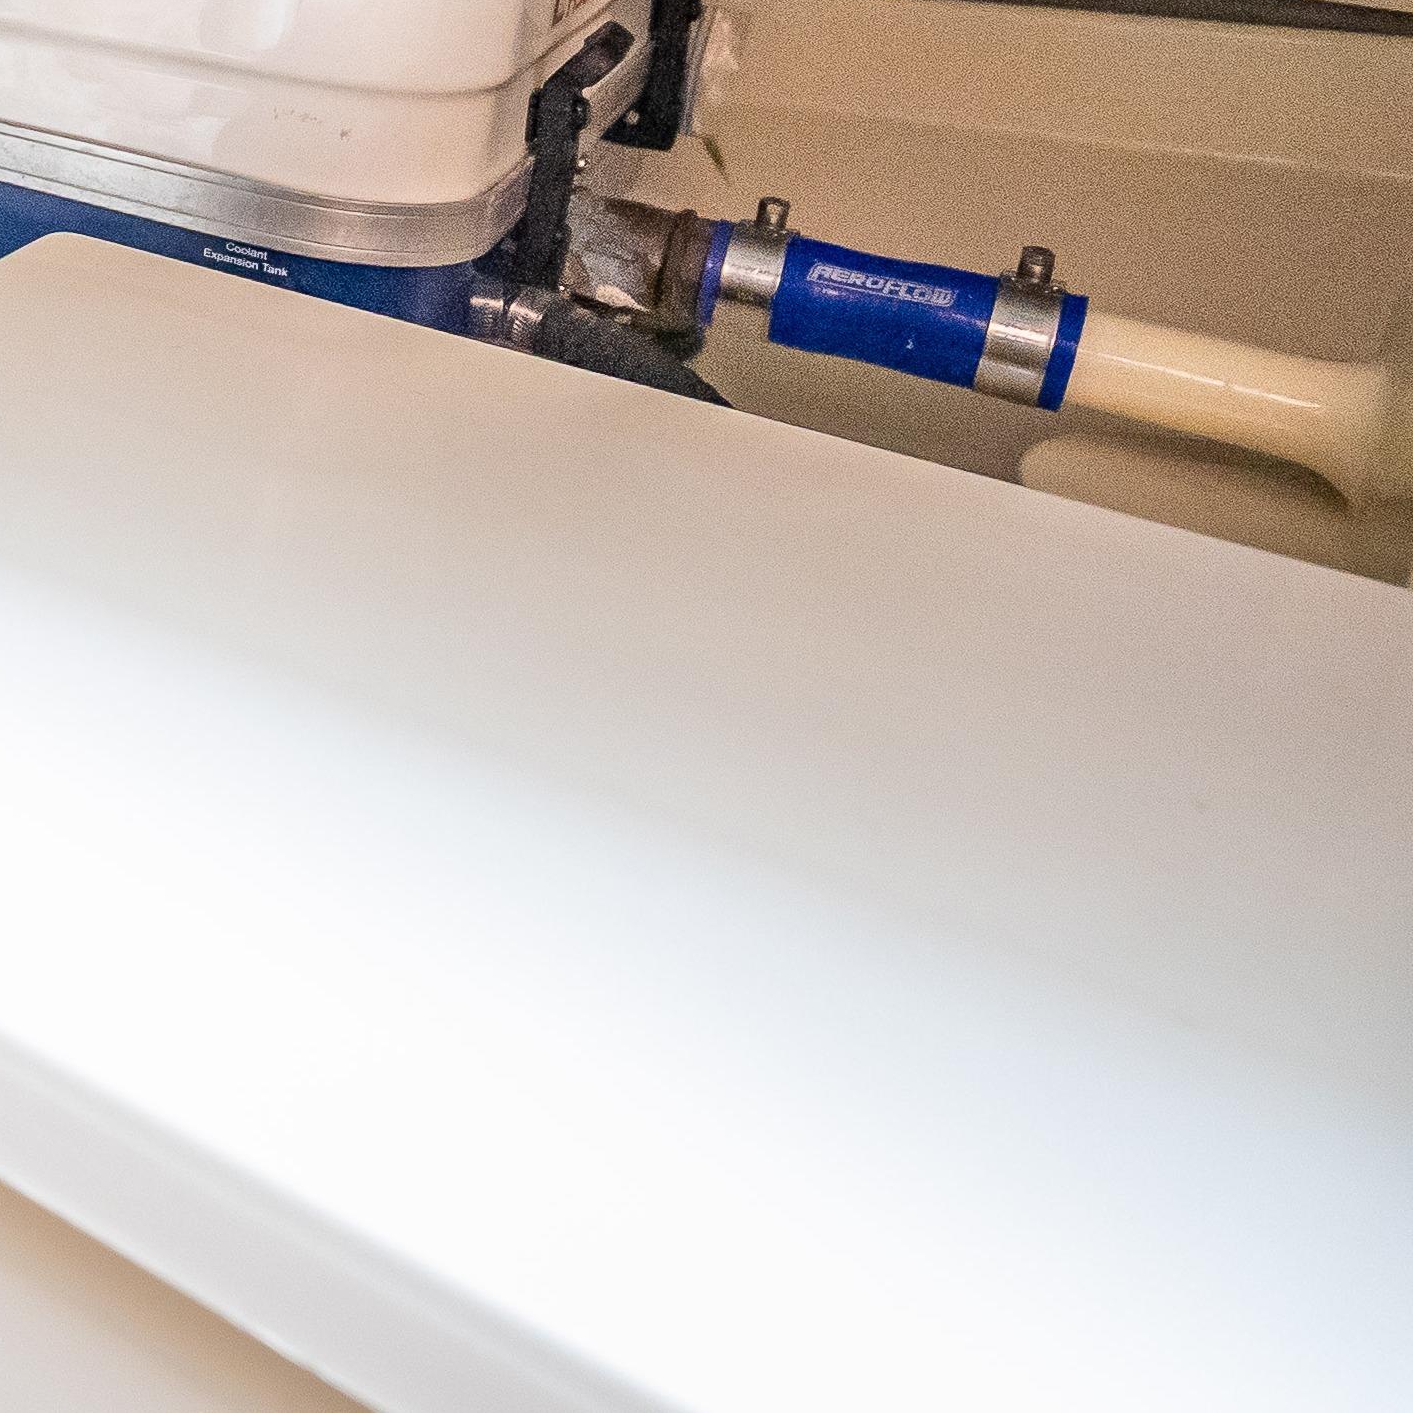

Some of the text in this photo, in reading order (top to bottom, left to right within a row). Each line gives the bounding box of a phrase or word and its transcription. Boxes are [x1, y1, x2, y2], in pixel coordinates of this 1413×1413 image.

[203, 247, 288, 277] Expansion Tank
[226, 242, 268, 261] Coolant
[806, 262, 957, 307] AEROFLOW
